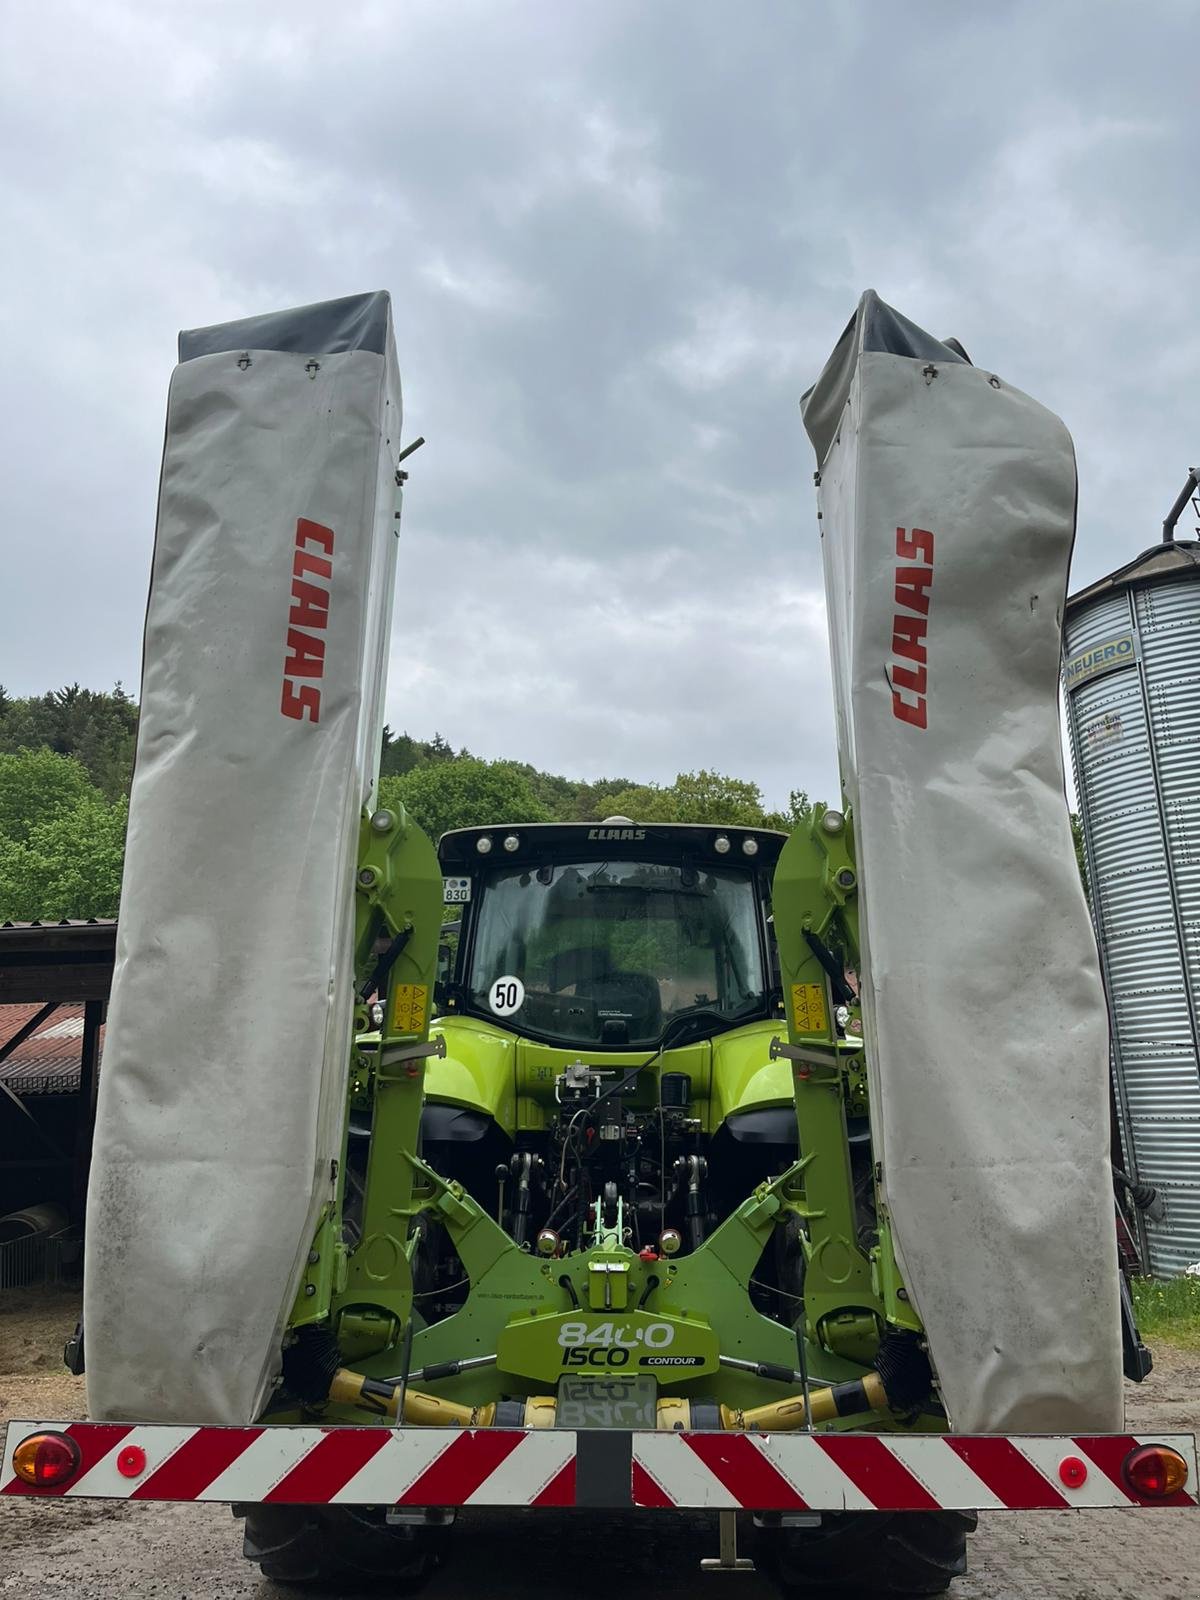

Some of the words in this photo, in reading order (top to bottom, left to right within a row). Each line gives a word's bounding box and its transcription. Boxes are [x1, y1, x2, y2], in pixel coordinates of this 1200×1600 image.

[281, 518, 335, 723] CLAAS
[892, 527, 934, 729] CLAAS
[1065, 641, 1132, 679] NEUERO
[587, 829, 646, 840] CLAAS
[446, 890, 468, 900] 830
[495, 983, 518, 1009] 50
[562, 1347, 629, 1366] ISCO
[647, 1357, 696, 1365] CONTOUR
